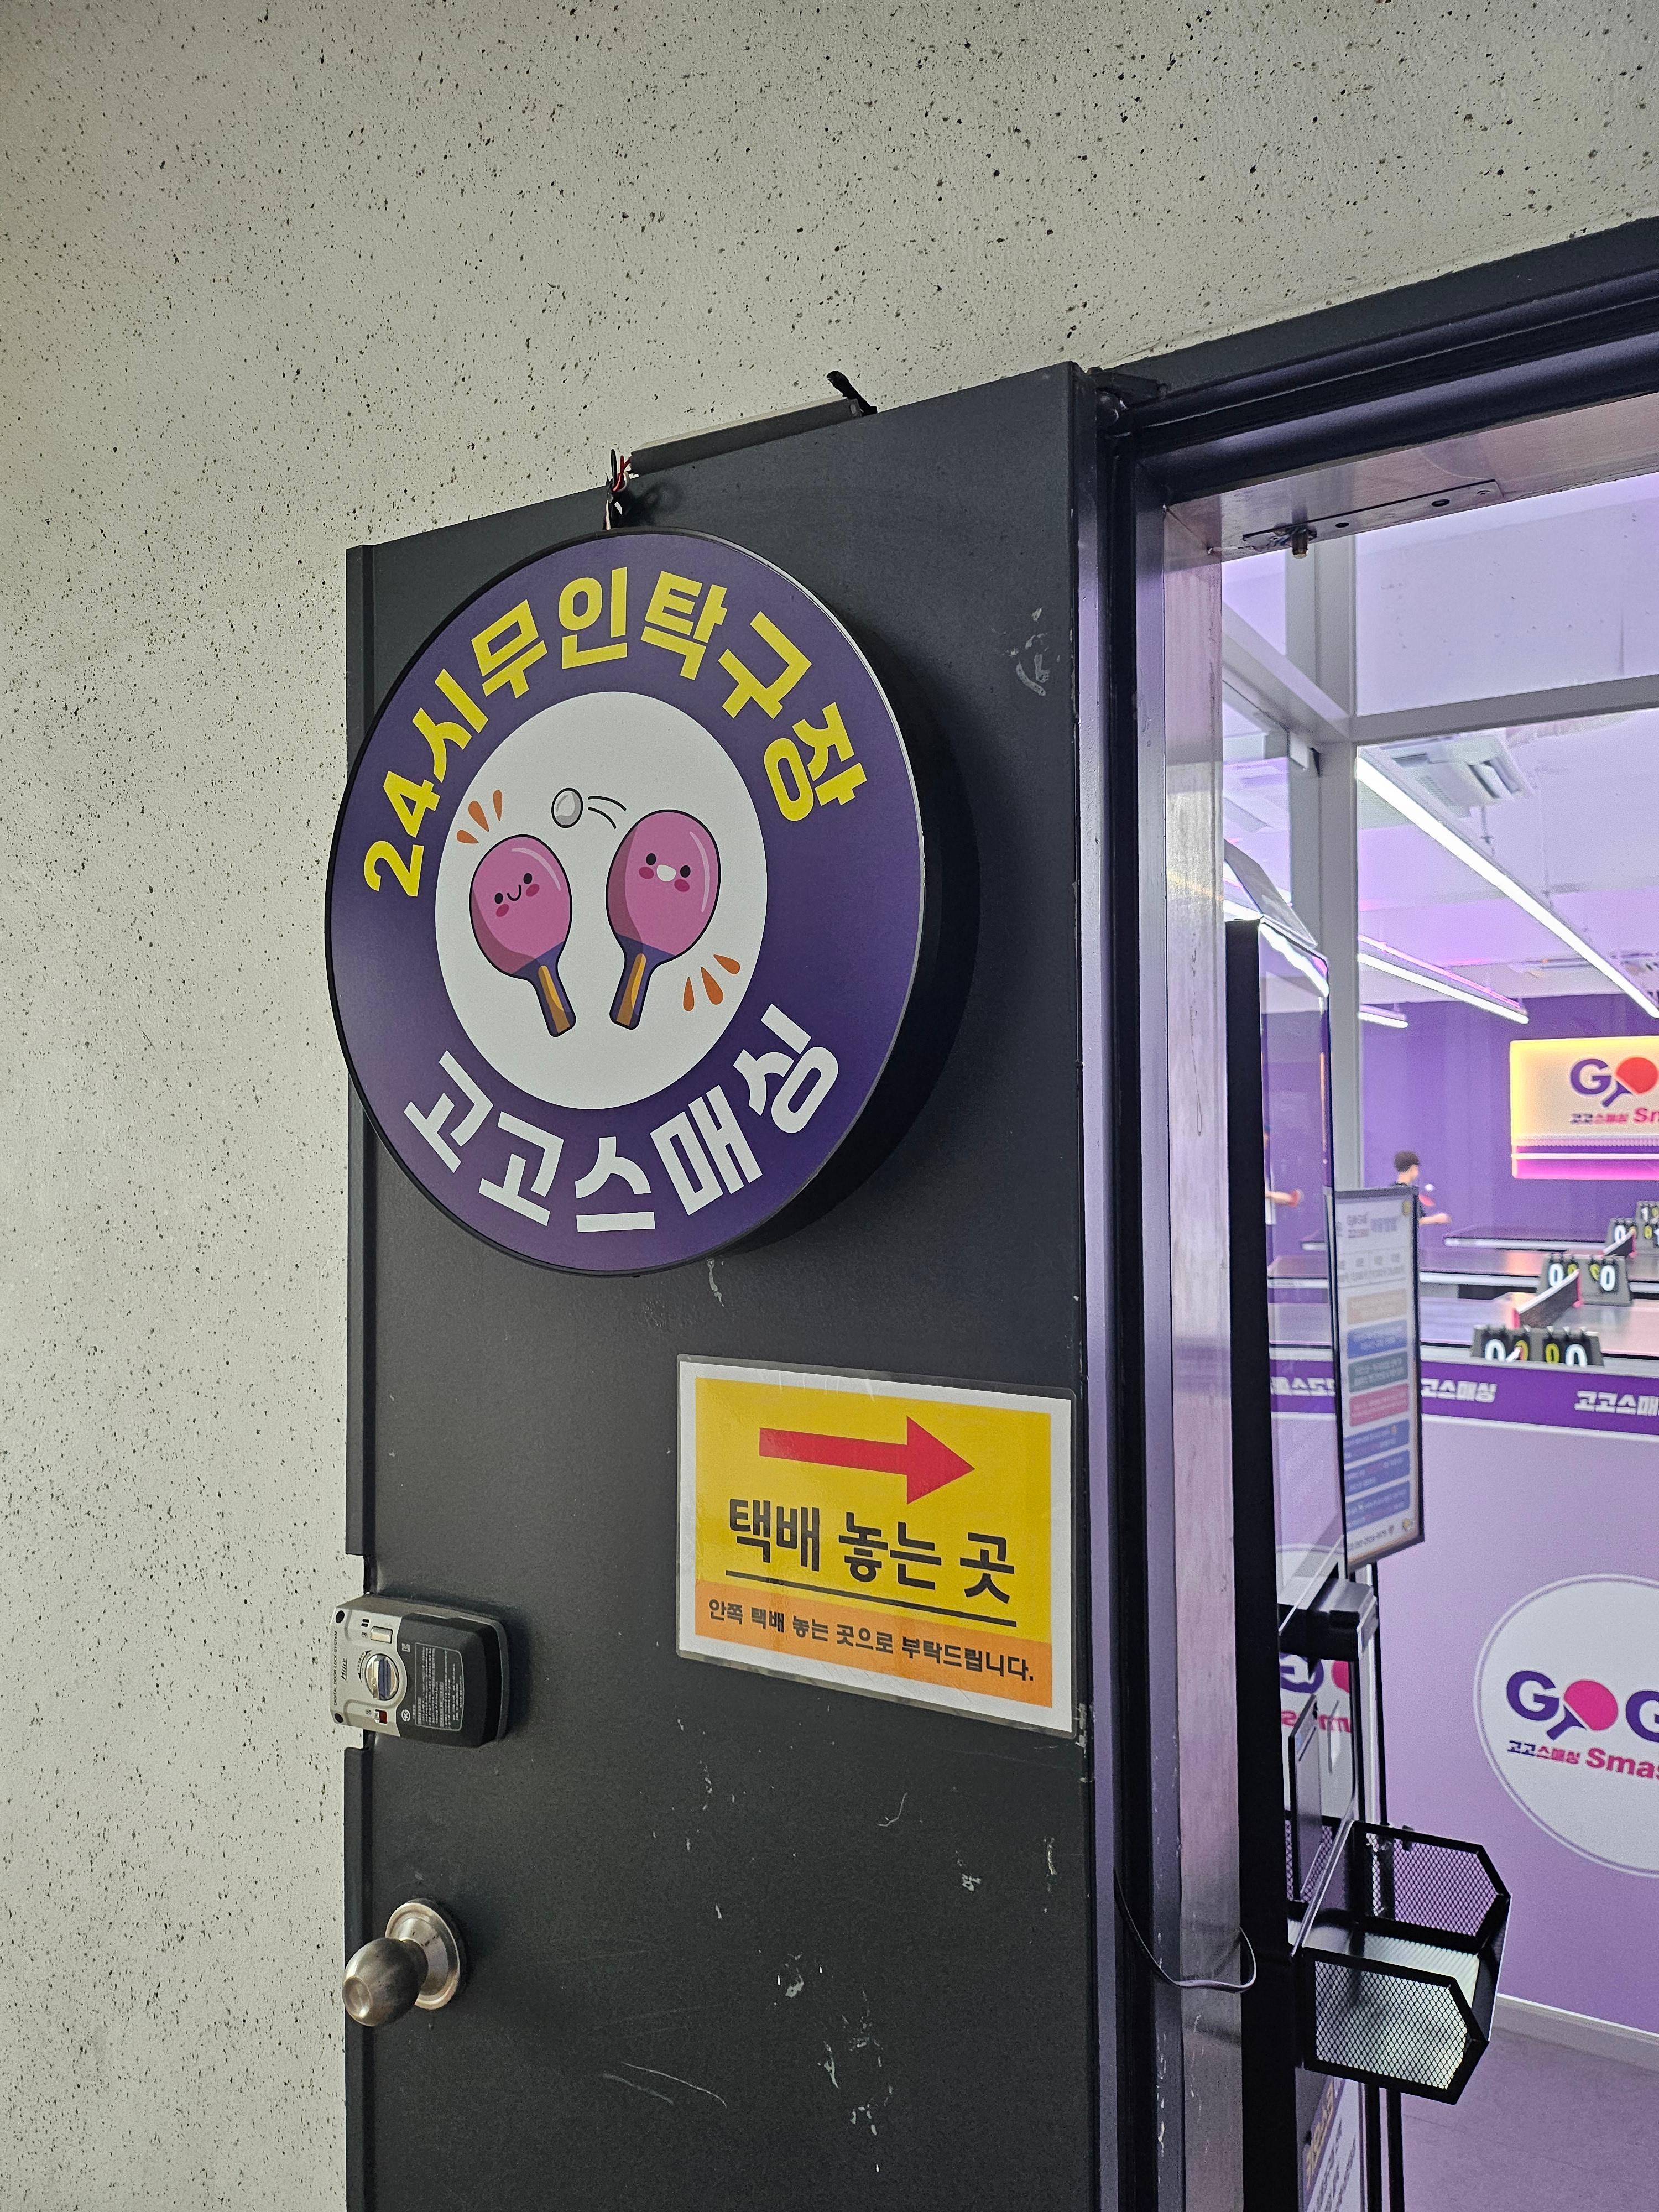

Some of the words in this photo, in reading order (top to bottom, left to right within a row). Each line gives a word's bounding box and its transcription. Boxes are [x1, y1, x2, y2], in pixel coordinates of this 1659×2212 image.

[403, 1004, 839, 1233] 고고스매싱
[1549, 1263, 1564, 1287] 0
[1600, 1265, 1616, 1291] 0
[1545, 1342, 1559, 1364] 0
[729, 1498, 820, 1572] 택배
[838, 1511, 942, 1591] 놓는
[959, 1531, 1015, 1604] 곳
[709, 1599, 743, 1625] 안쪽
[750, 1606, 785, 1634] 택배
[792, 1615, 829, 1642] 놓는
[836, 1623, 894, 1655] 곳으로
[901, 1636, 1034, 1682] 부탁드립니다.
[1585, 1747, 1659, 1780] Sma
